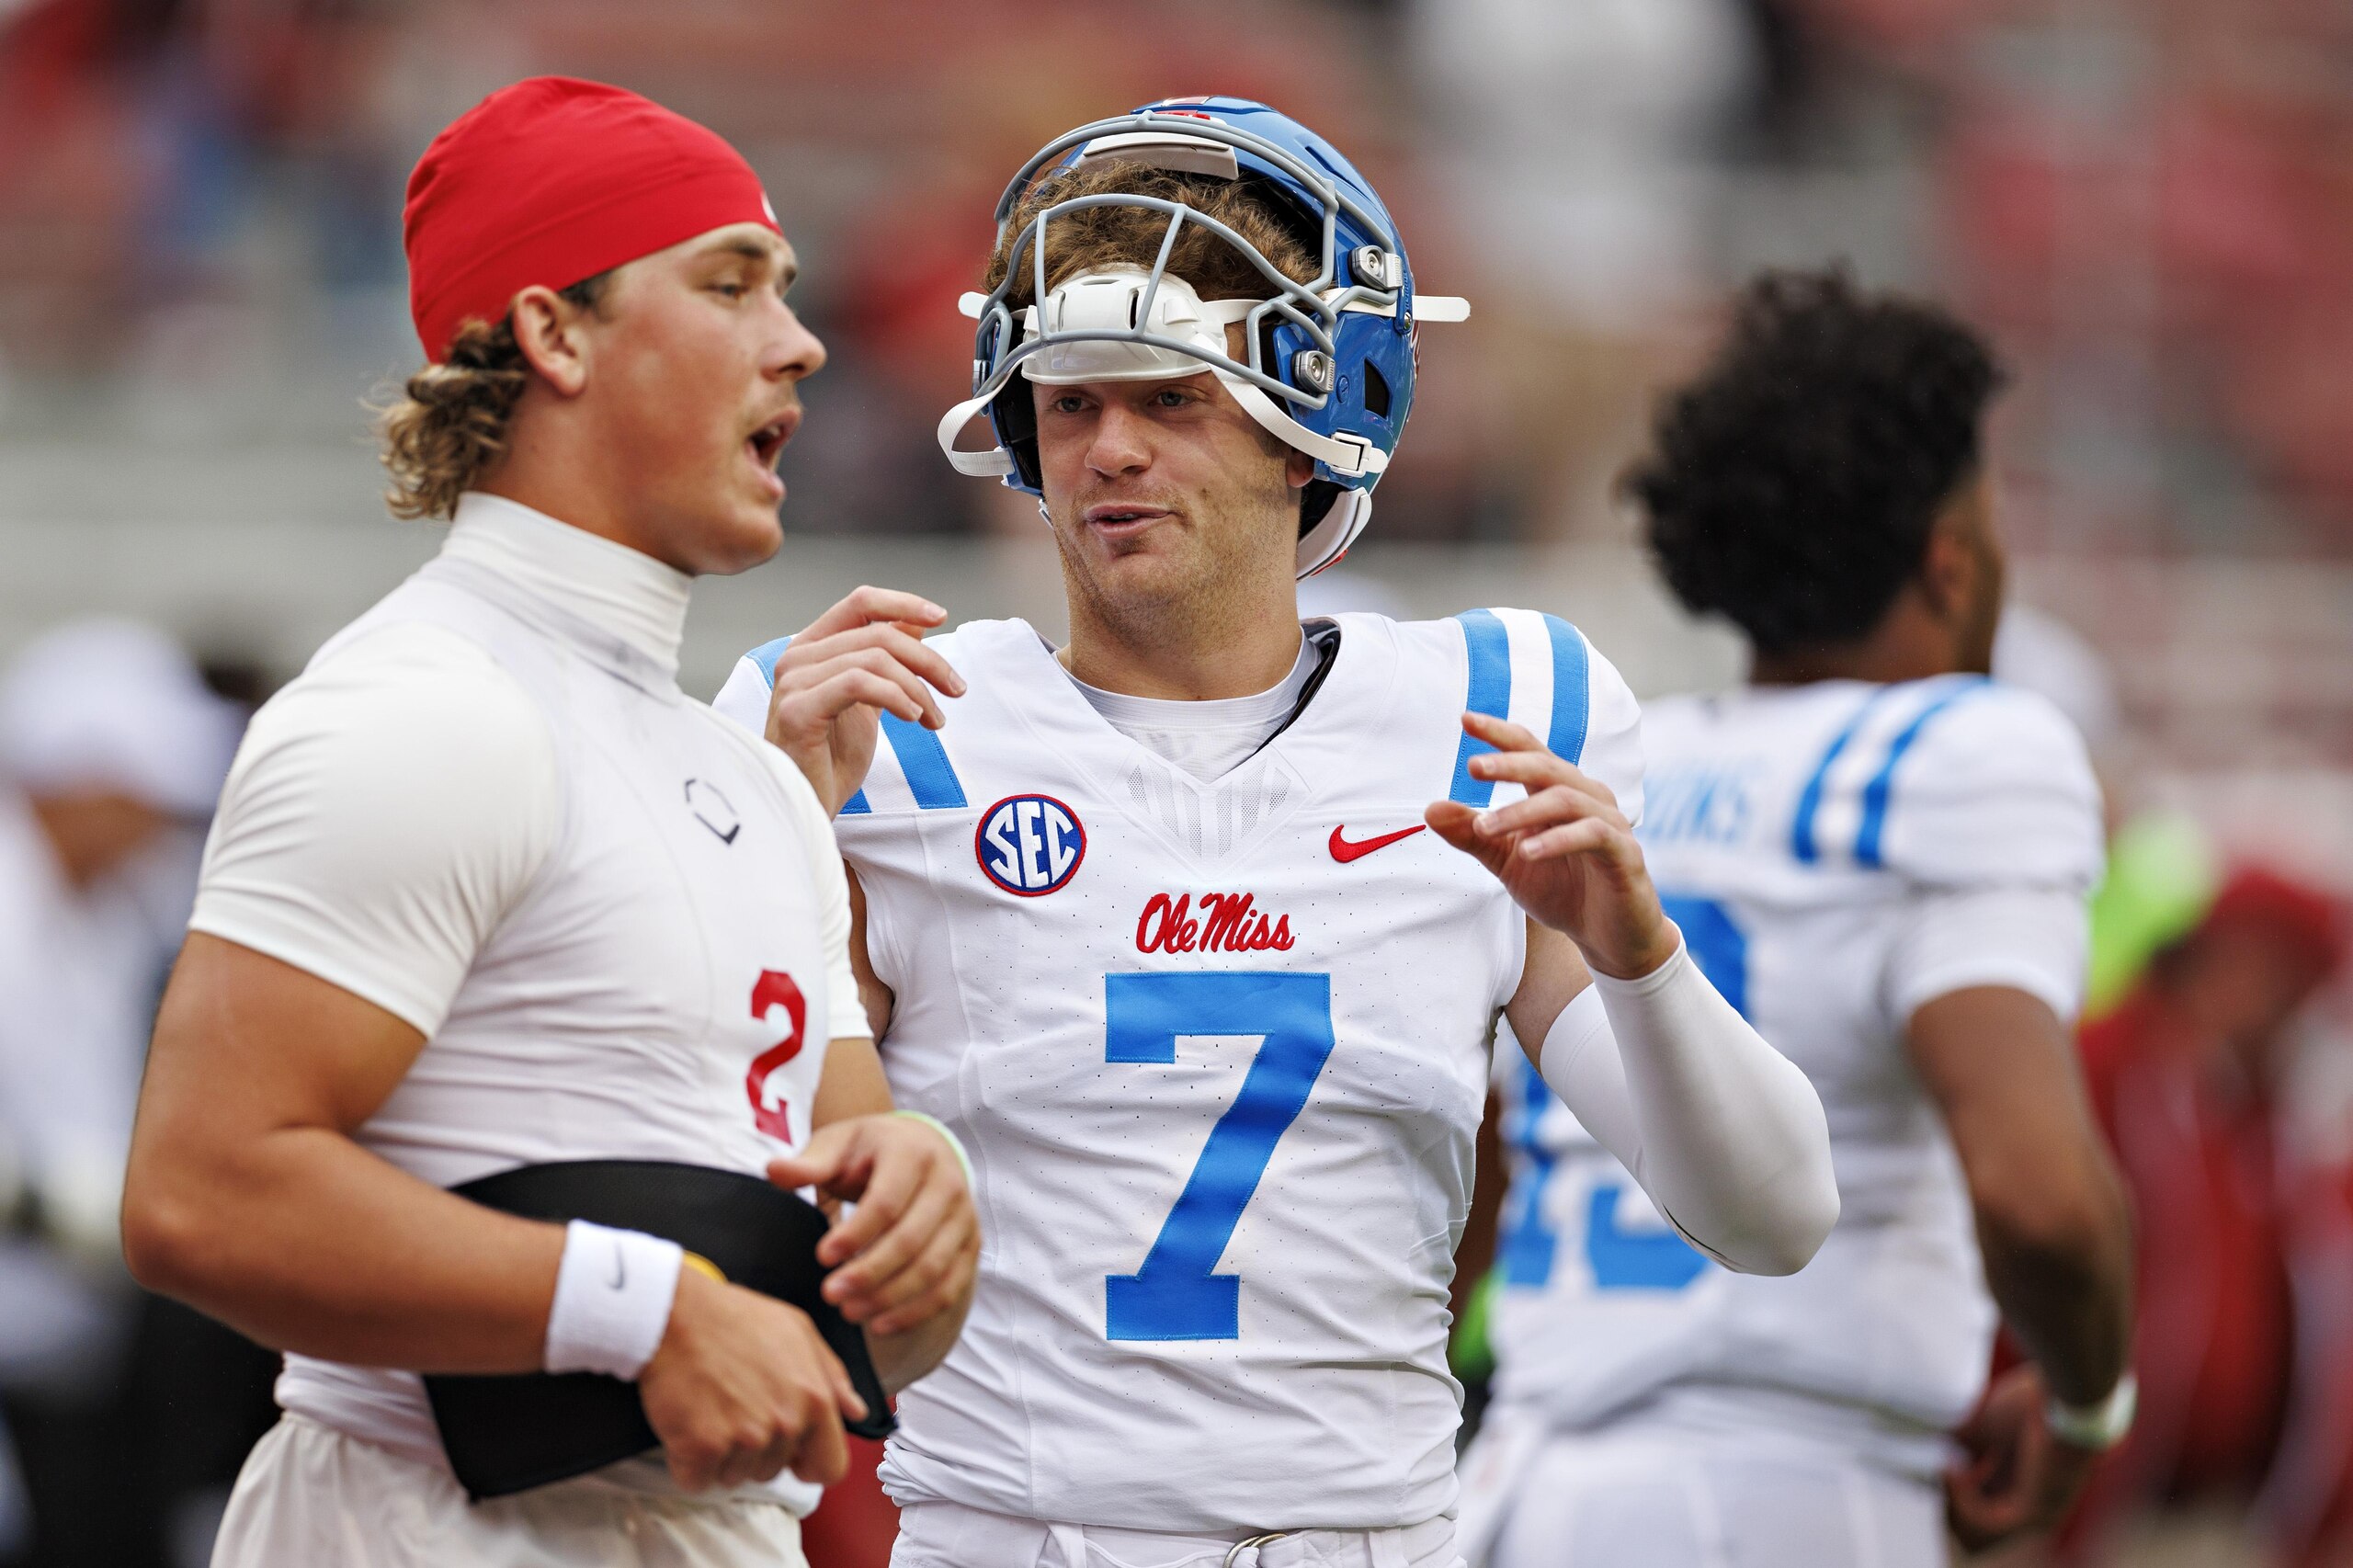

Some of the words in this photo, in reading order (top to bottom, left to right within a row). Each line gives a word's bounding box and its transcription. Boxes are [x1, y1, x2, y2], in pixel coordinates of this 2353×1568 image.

[984, 801, 1076, 889] SEC
[1136, 892, 1198, 954] Ole
[1199, 892, 1295, 953] Miss
[745, 969, 805, 1146] 2
[1105, 971, 1336, 1341] 7
